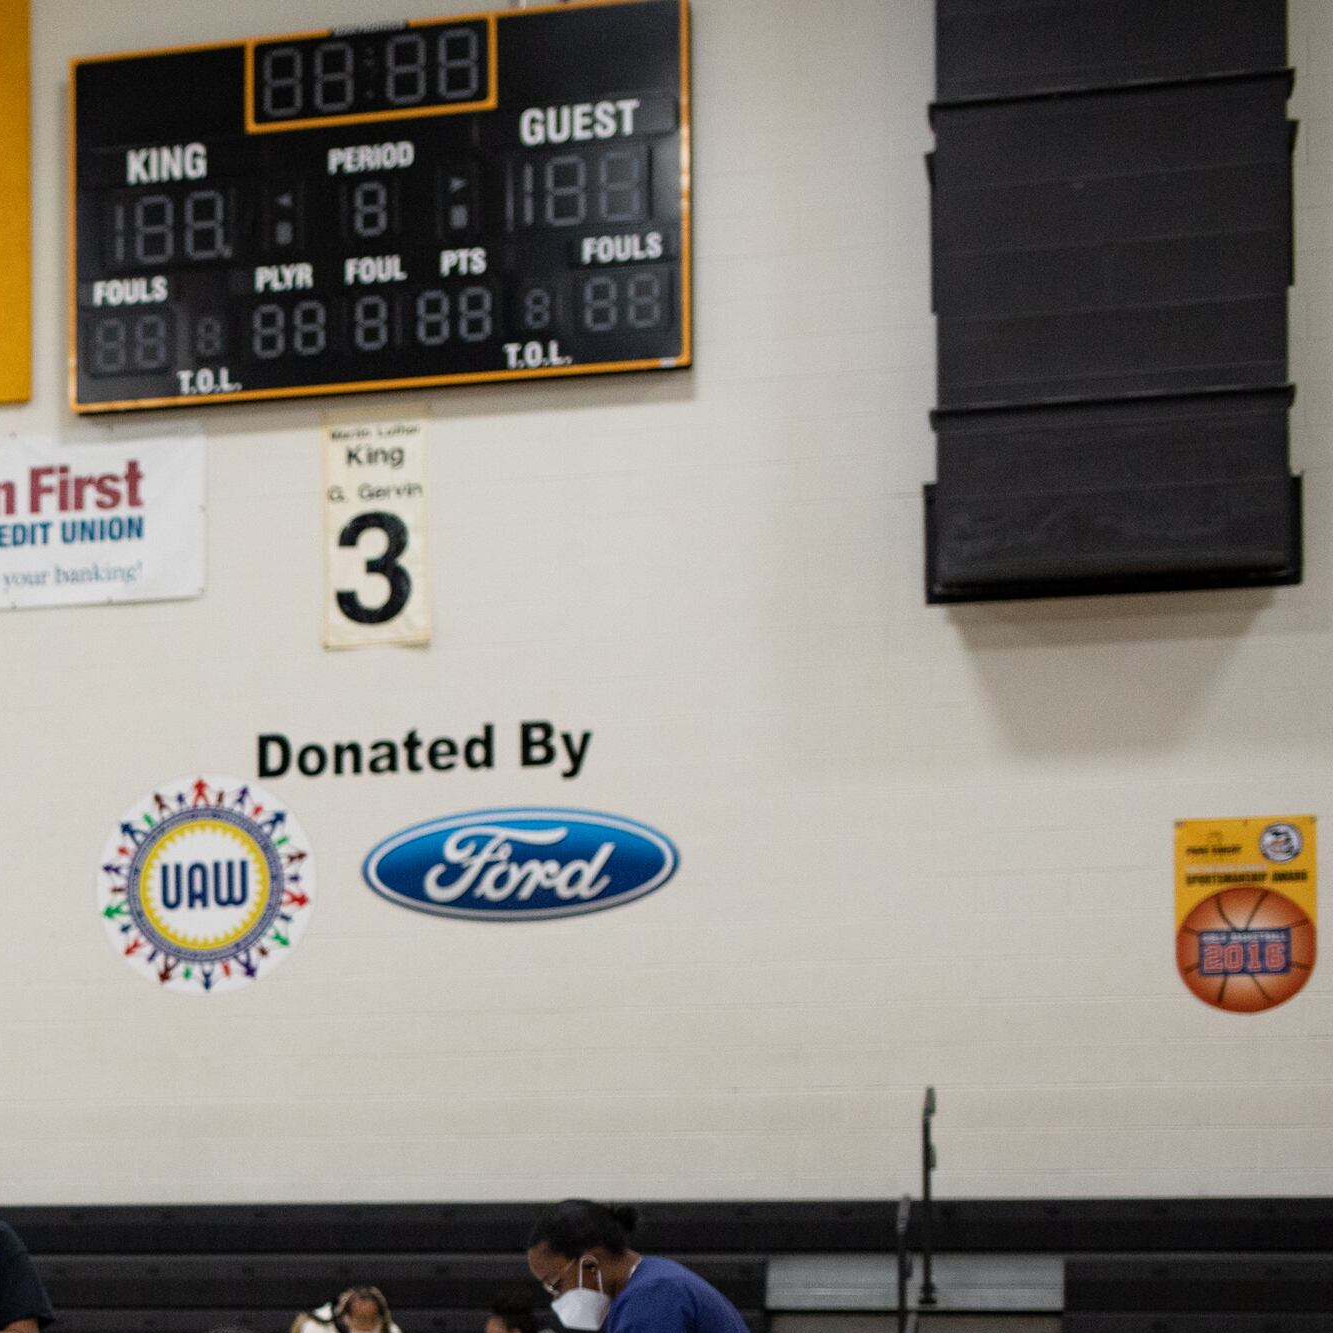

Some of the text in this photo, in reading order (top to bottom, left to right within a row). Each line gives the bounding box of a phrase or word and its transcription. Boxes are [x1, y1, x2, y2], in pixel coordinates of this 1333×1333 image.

[520, 100, 639, 145] GUEST
[127, 143, 207, 184] KING
[328, 141, 414, 175] PERIOD
[441, 247, 486, 277] PTS
[581, 233, 663, 264] FOULS
[255, 262, 314, 293] PLYR
[345, 255, 407, 286] FOUL
[93, 276, 168, 305] FOULS
[504, 343, 572, 368] T.O.L.
[177, 369, 242, 394] T.O.L.
[346, 447, 405, 469] King
[29, 458, 144, 514] First
[61, 515, 144, 545] UNION
[3, 566, 48, 588] your
[336, 510, 412, 625] 3
[256, 720, 593, 779] Donated By
[423, 825, 618, 902] Ford
[159, 859, 251, 910] UAW
[1203, 941, 1286, 973] 2016
